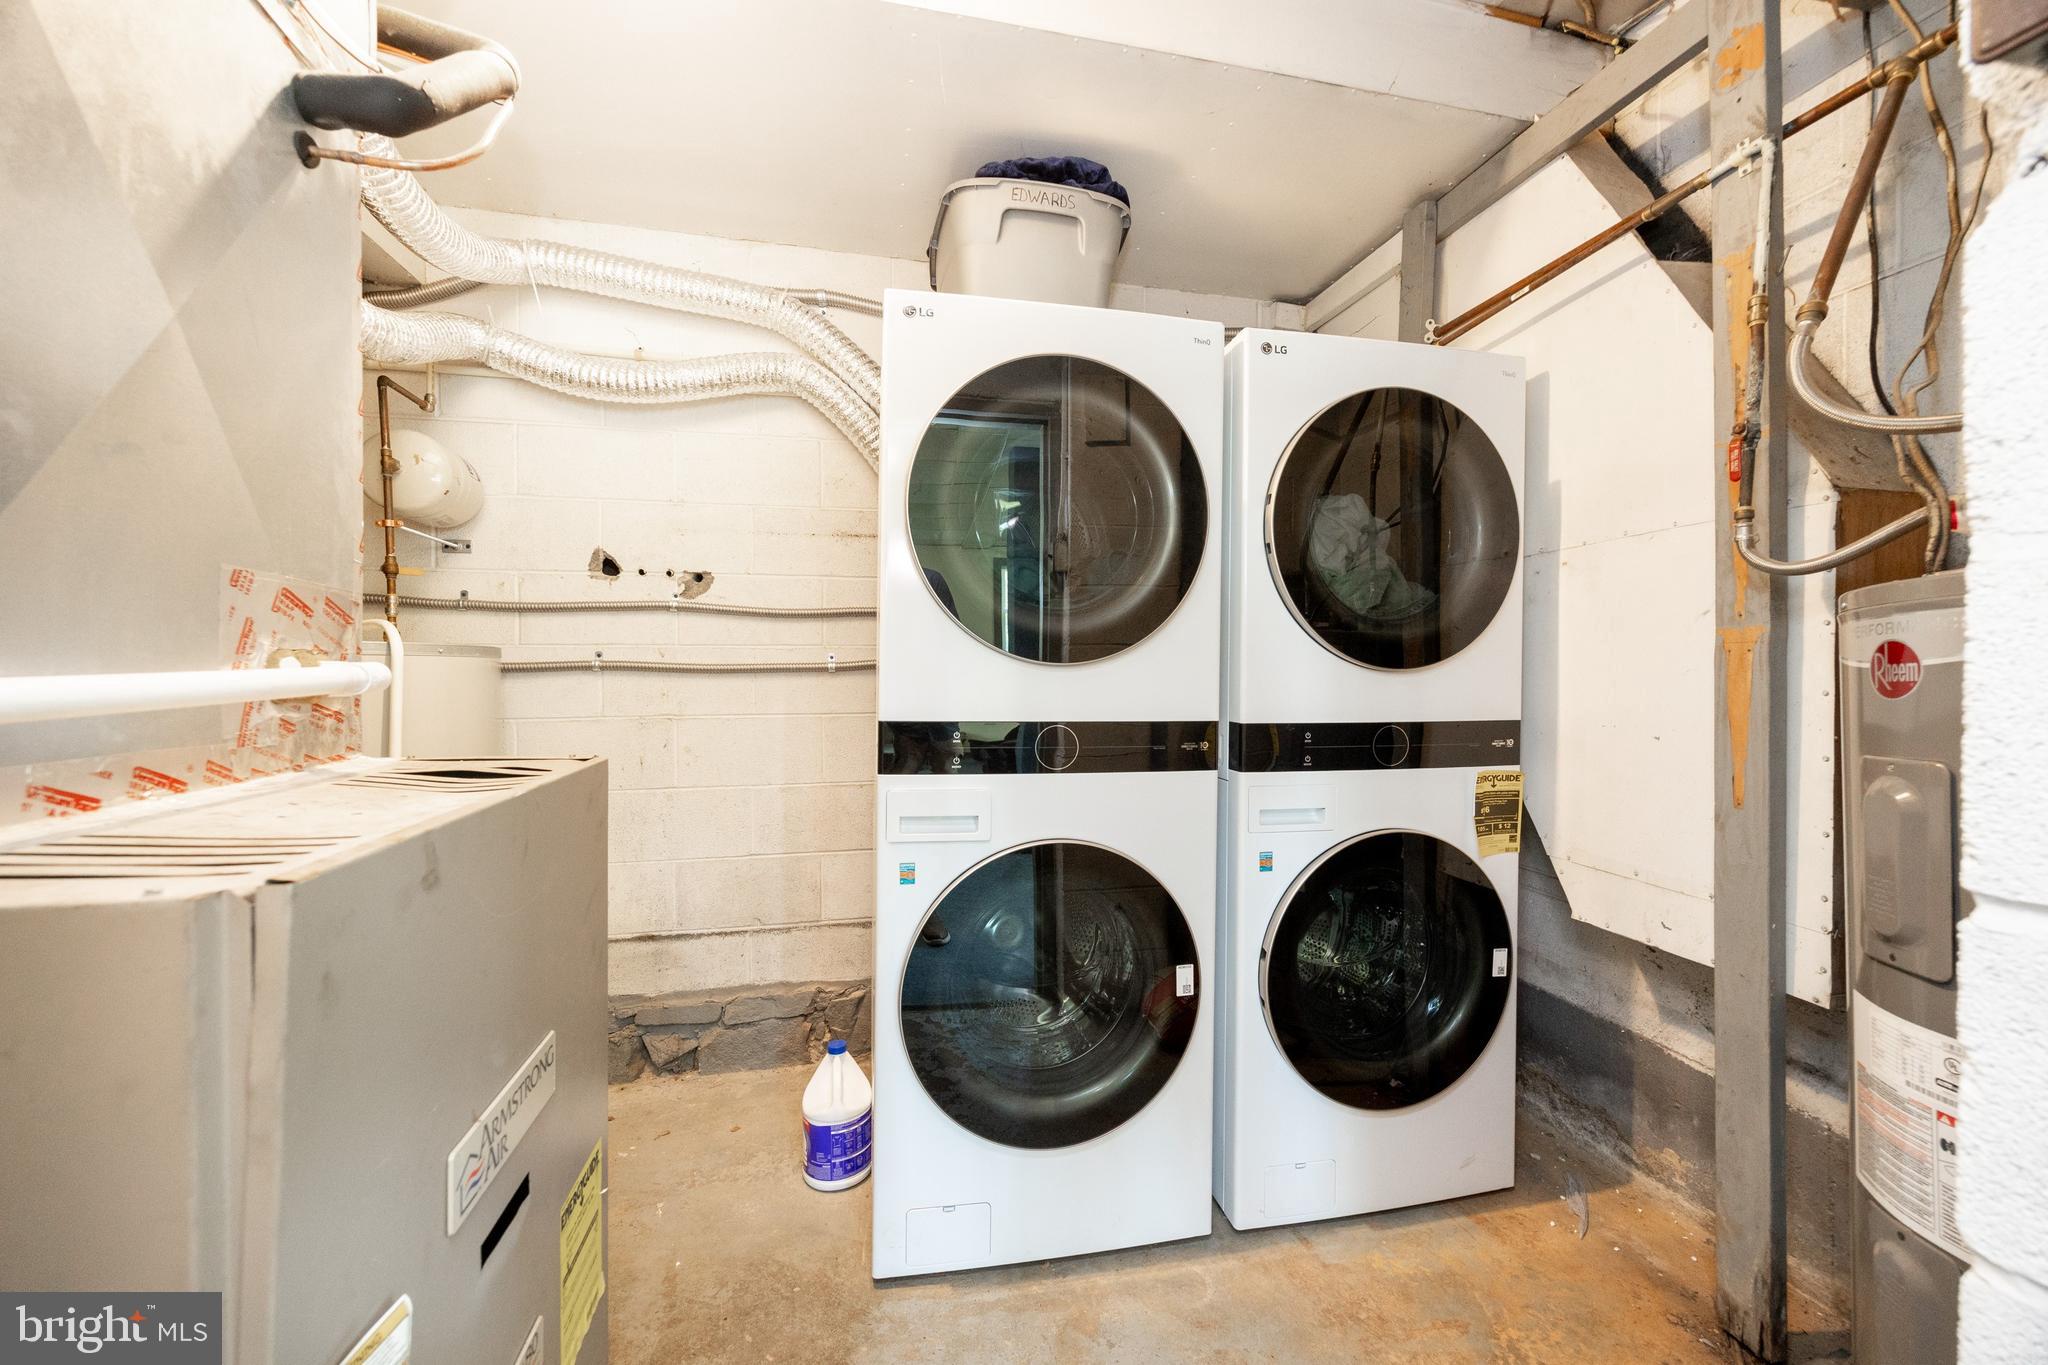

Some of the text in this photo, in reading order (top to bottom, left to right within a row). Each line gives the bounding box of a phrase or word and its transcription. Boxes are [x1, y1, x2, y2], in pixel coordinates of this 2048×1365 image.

[1011, 187, 1076, 209] EDWARDS
[918, 307, 935, 318] LG
[1274, 344, 1288, 355] LG
[1873, 641, 1919, 691] Rheem
[479, 1044, 555, 1160] ARMSTRONG
[485, 1134, 509, 1183] AIR
